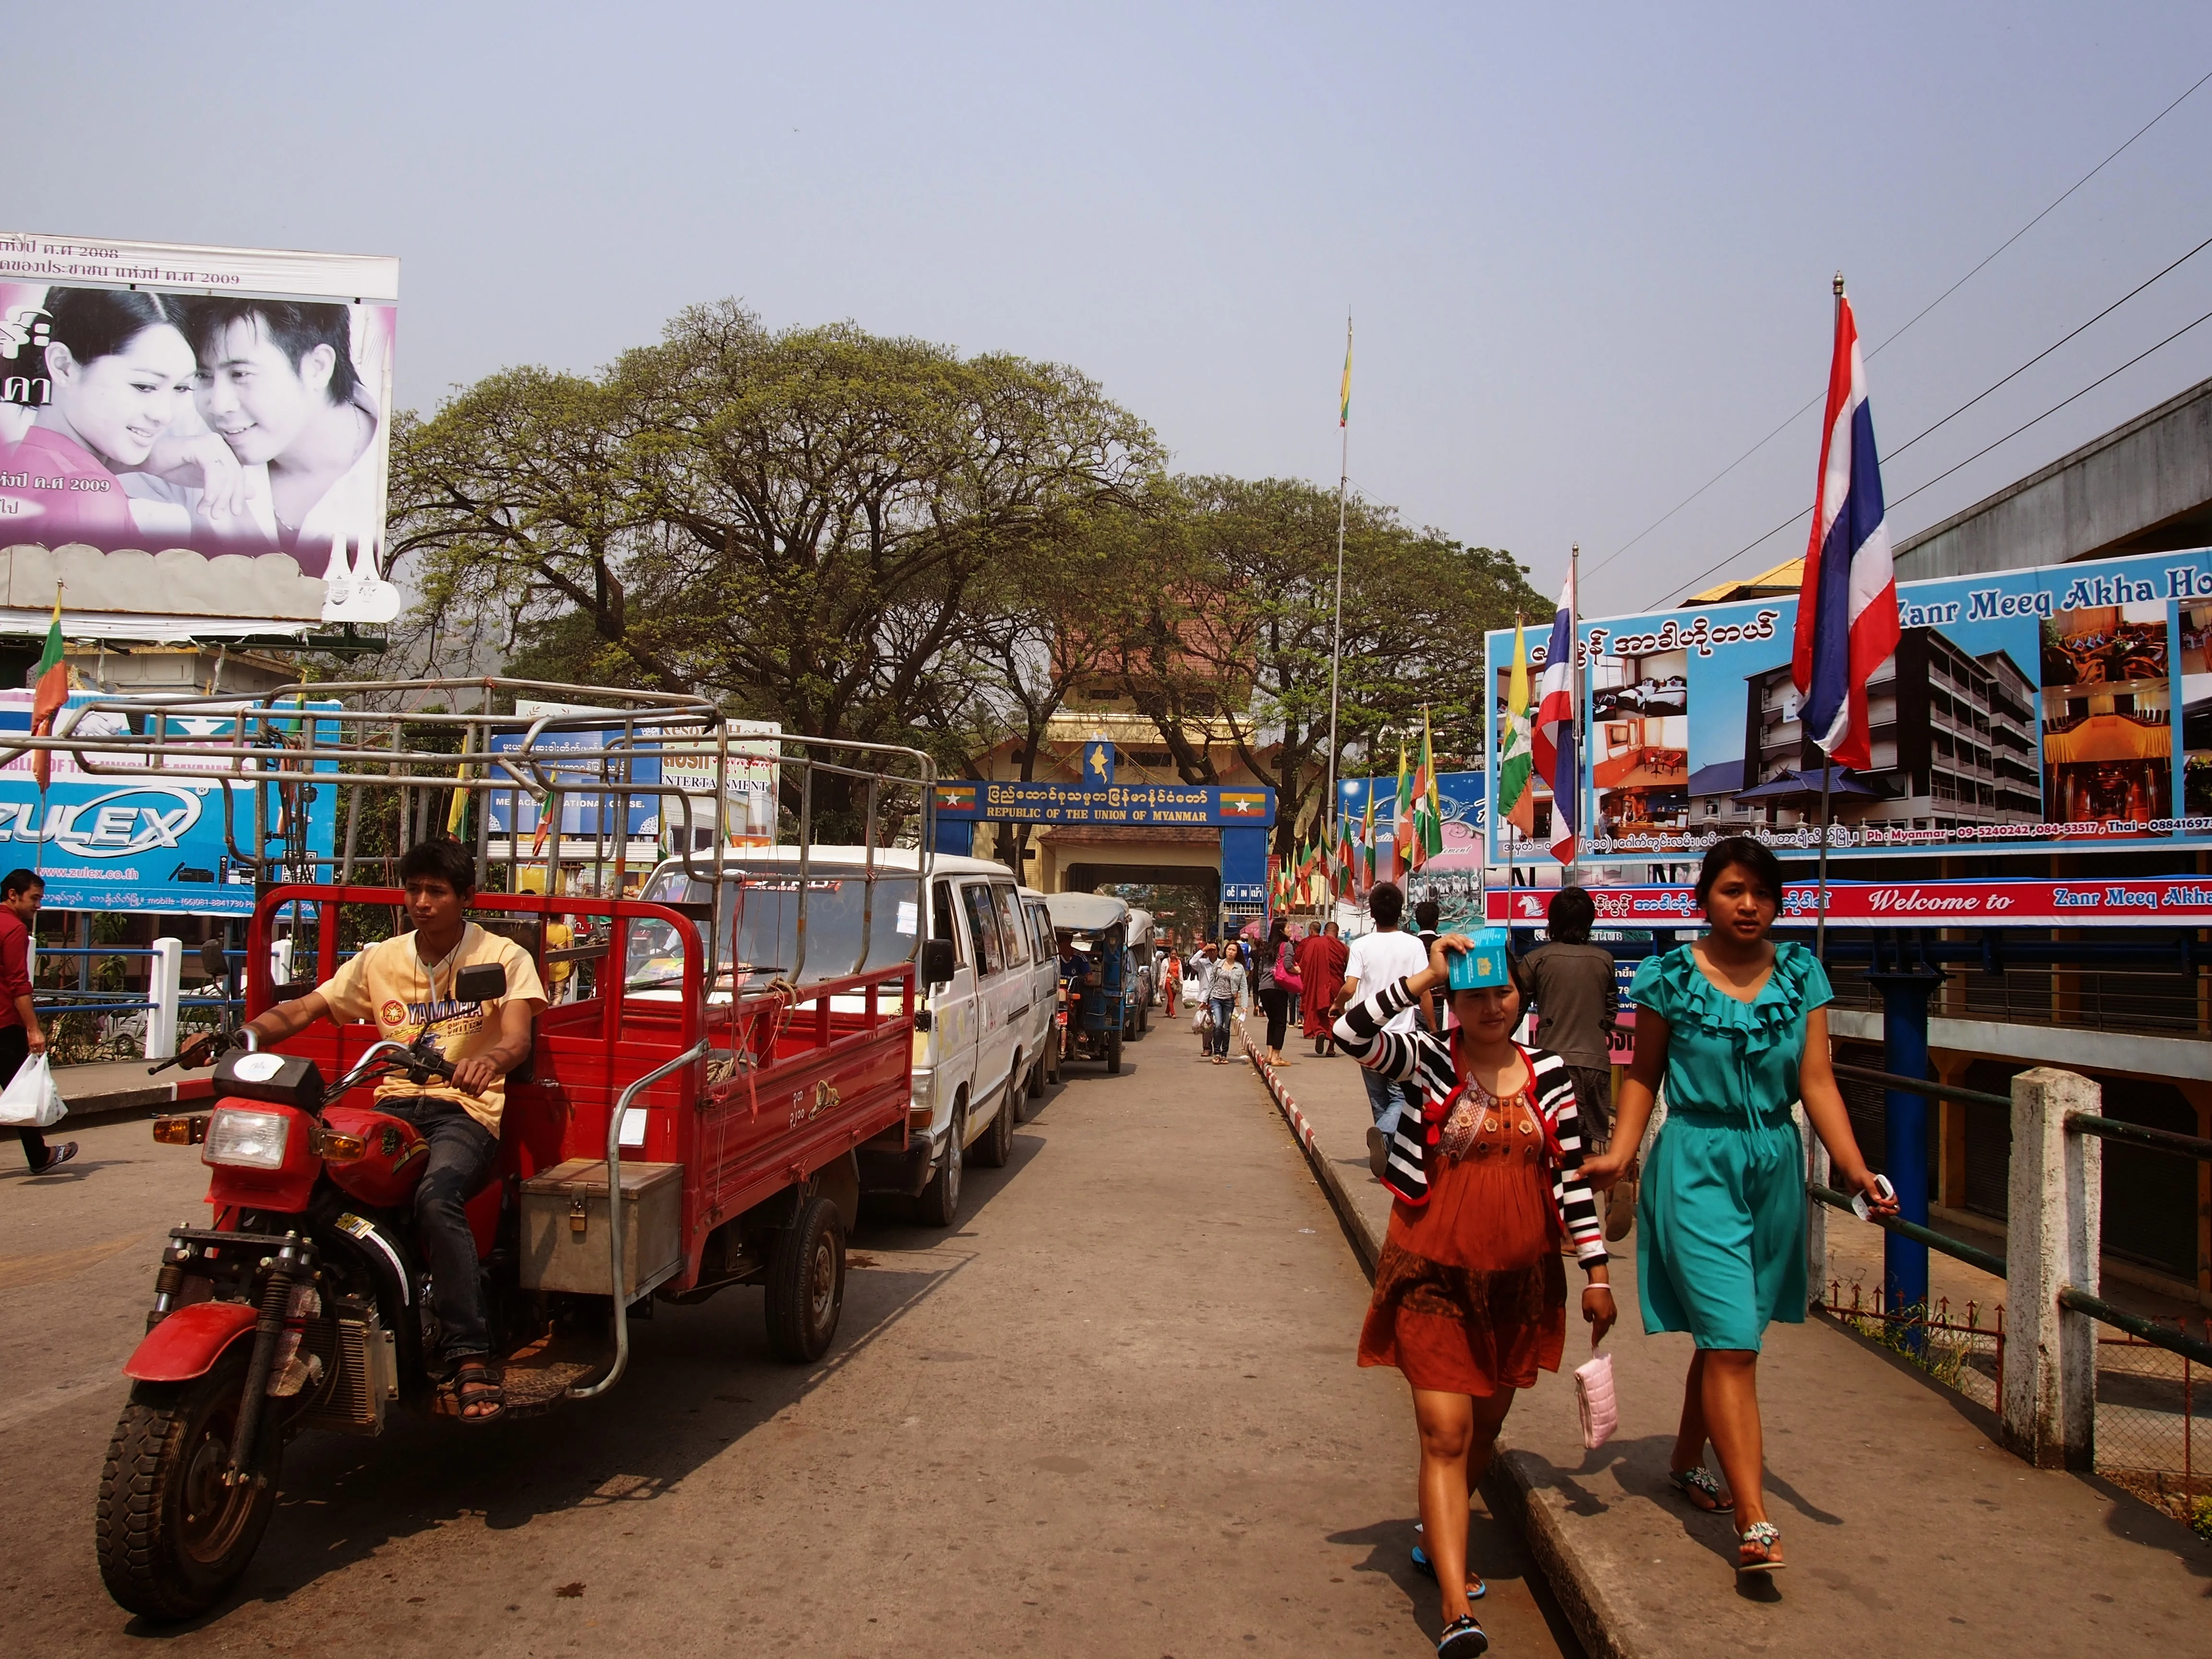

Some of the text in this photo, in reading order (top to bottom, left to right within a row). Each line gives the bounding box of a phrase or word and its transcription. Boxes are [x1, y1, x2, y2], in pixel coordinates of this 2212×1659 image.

[79, 247, 119, 259] 2008
[201, 273, 240, 284] 2009
[70, 479, 110, 492] 2009
[1968, 590, 2051, 619] Meeq
[2065, 576, 2154, 610] Akha
[662, 775, 768, 791] NTERTANMENT
[987, 807, 1207, 822] REPUBLIC OF THE UNION OF MYANMAR
[0, 803, 180, 849] ZULEX
[1891, 829, 1946, 842] Myanmar
[1958, 826, 2029, 836] 09-5240242
[2108, 821, 2136, 831] Thai
[35, 867, 139, 880] www.zulex.co.th
[1240, 889, 1247, 897] IN
[1868, 890, 2015, 911] Welcome to
[2055, 889, 2100, 905] Zanr
[2105, 888, 2157, 908] Meeq
